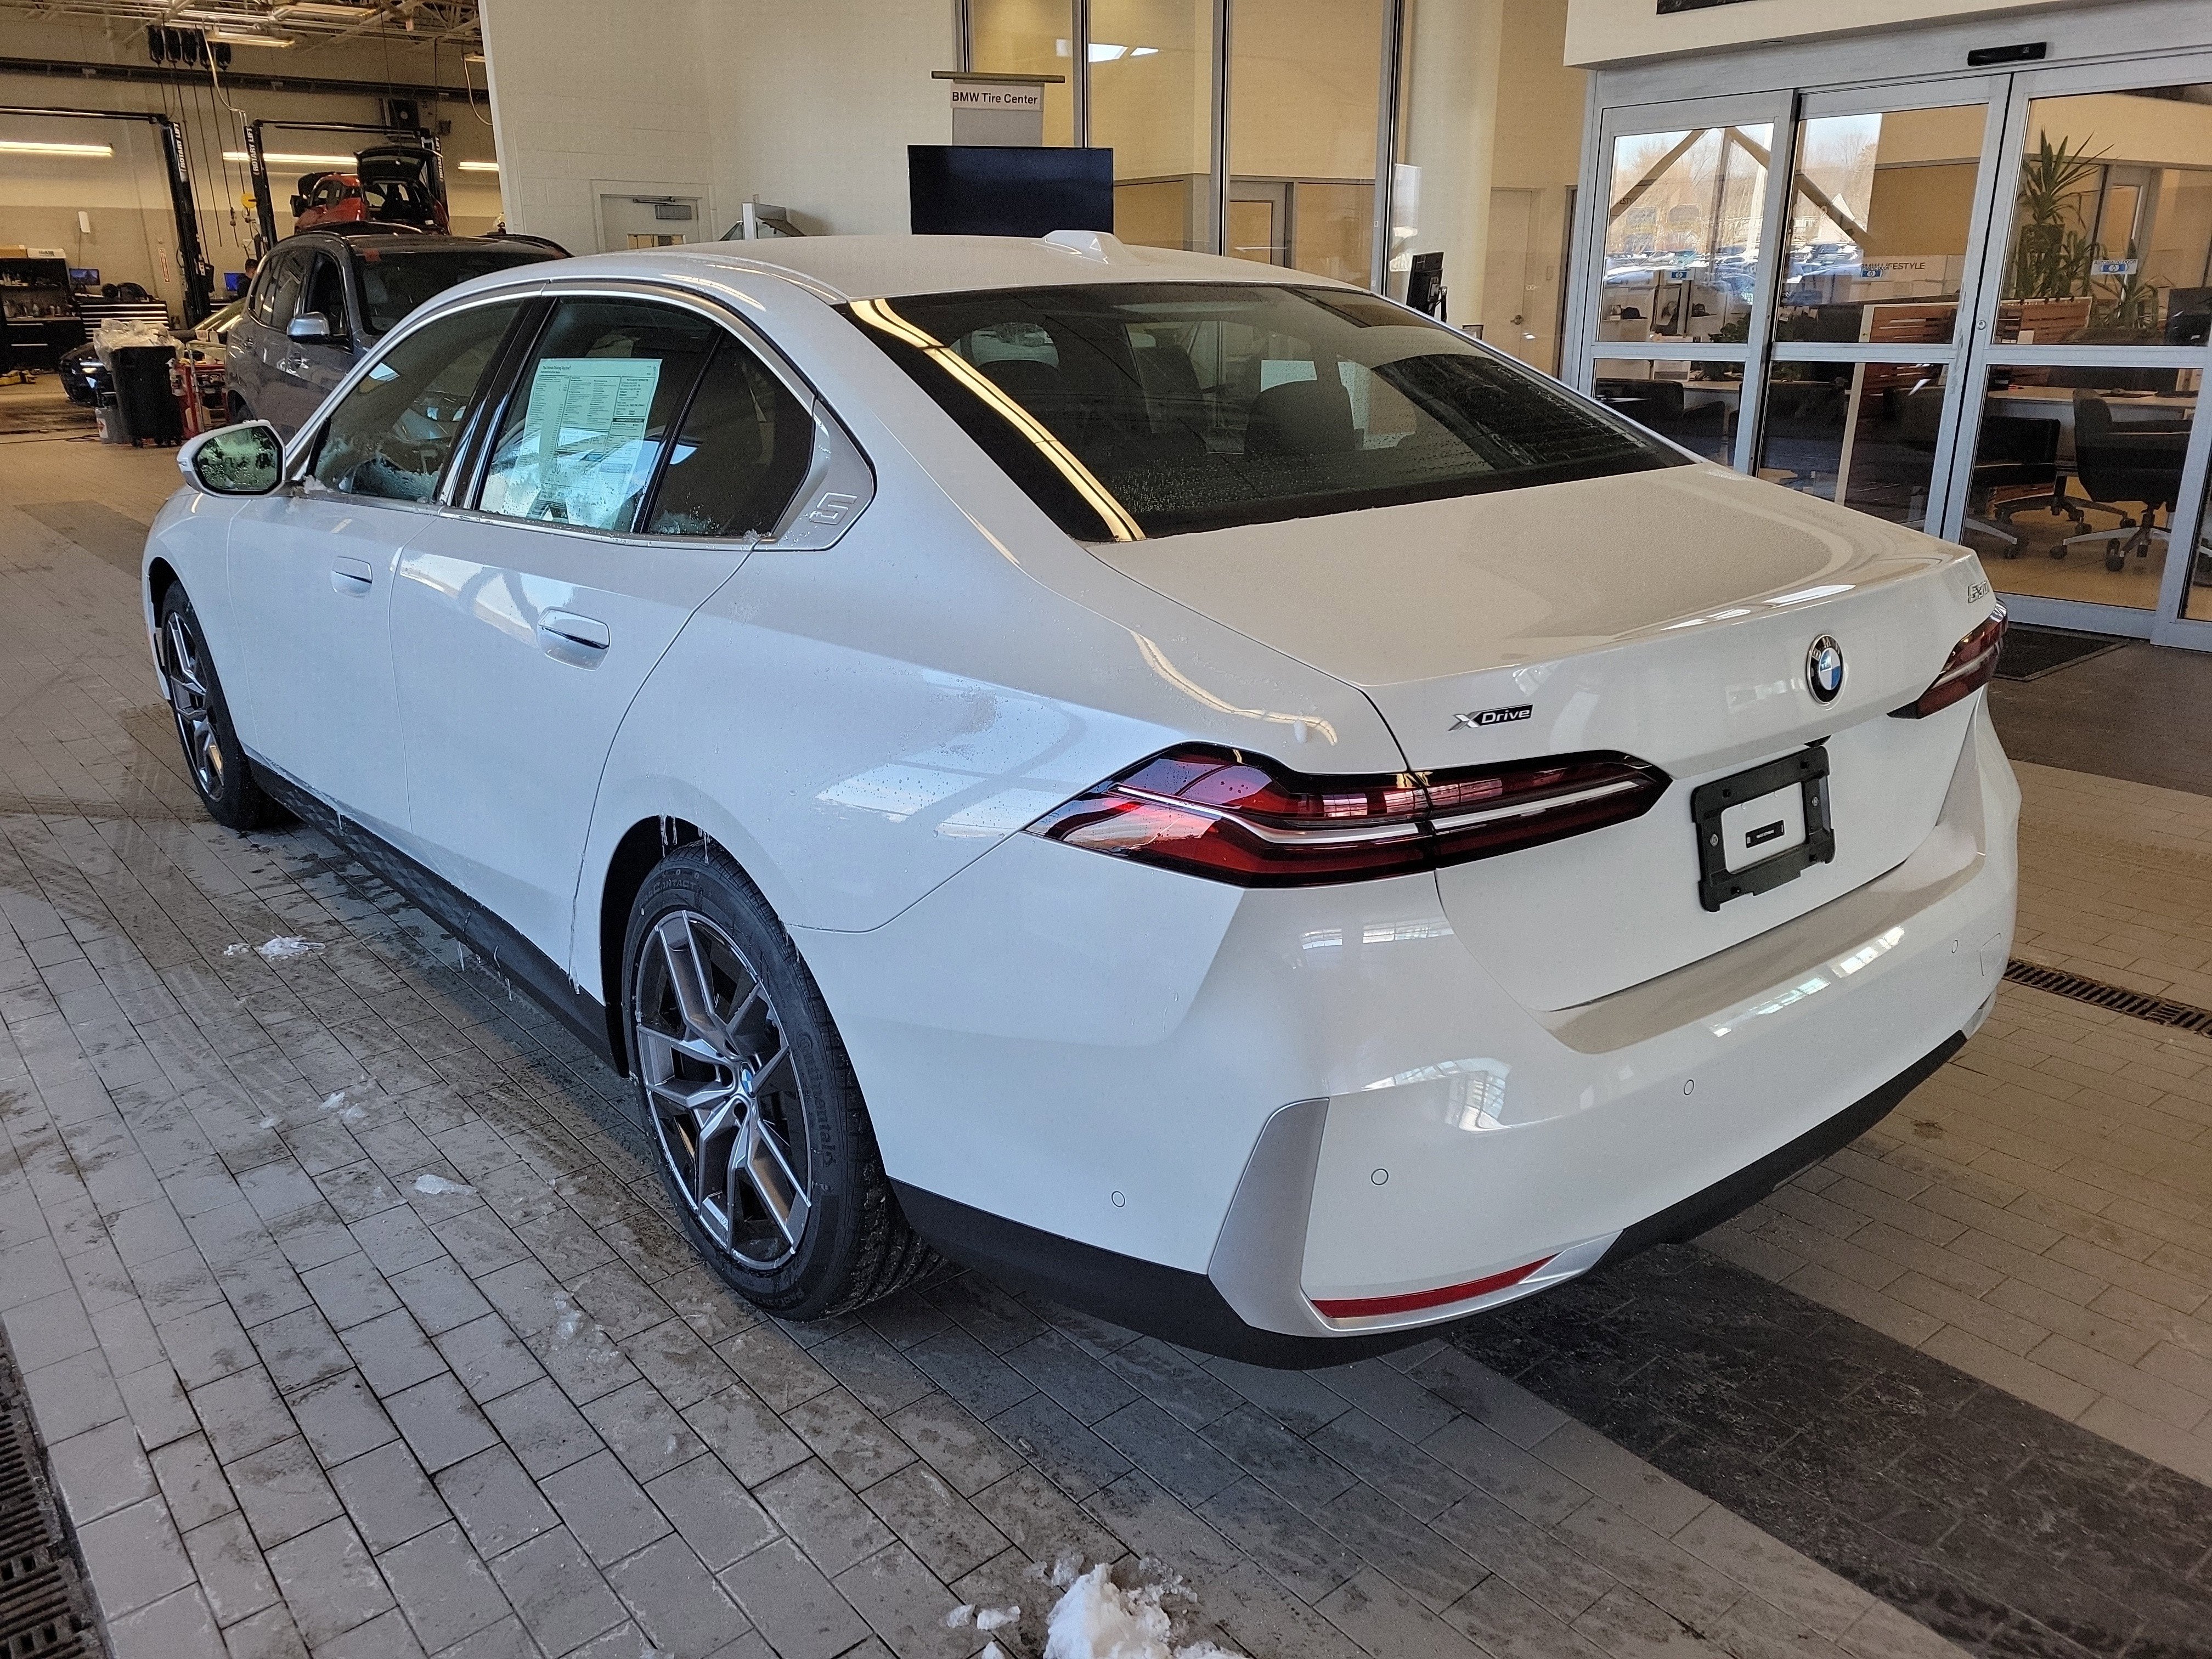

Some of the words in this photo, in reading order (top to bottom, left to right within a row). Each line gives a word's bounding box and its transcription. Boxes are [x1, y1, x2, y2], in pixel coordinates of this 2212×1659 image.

[952, 91, 979, 102] BMW
[981, 92, 1001, 103] Tire
[1003, 93, 1038, 104] Center
[173, 122, 181, 138] LIFT
[246, 127, 254, 142] LIFT
[176, 139, 185, 168] ROTARY
[249, 143, 259, 171] ROTARY
[1812, 637, 1841, 661] BMW
